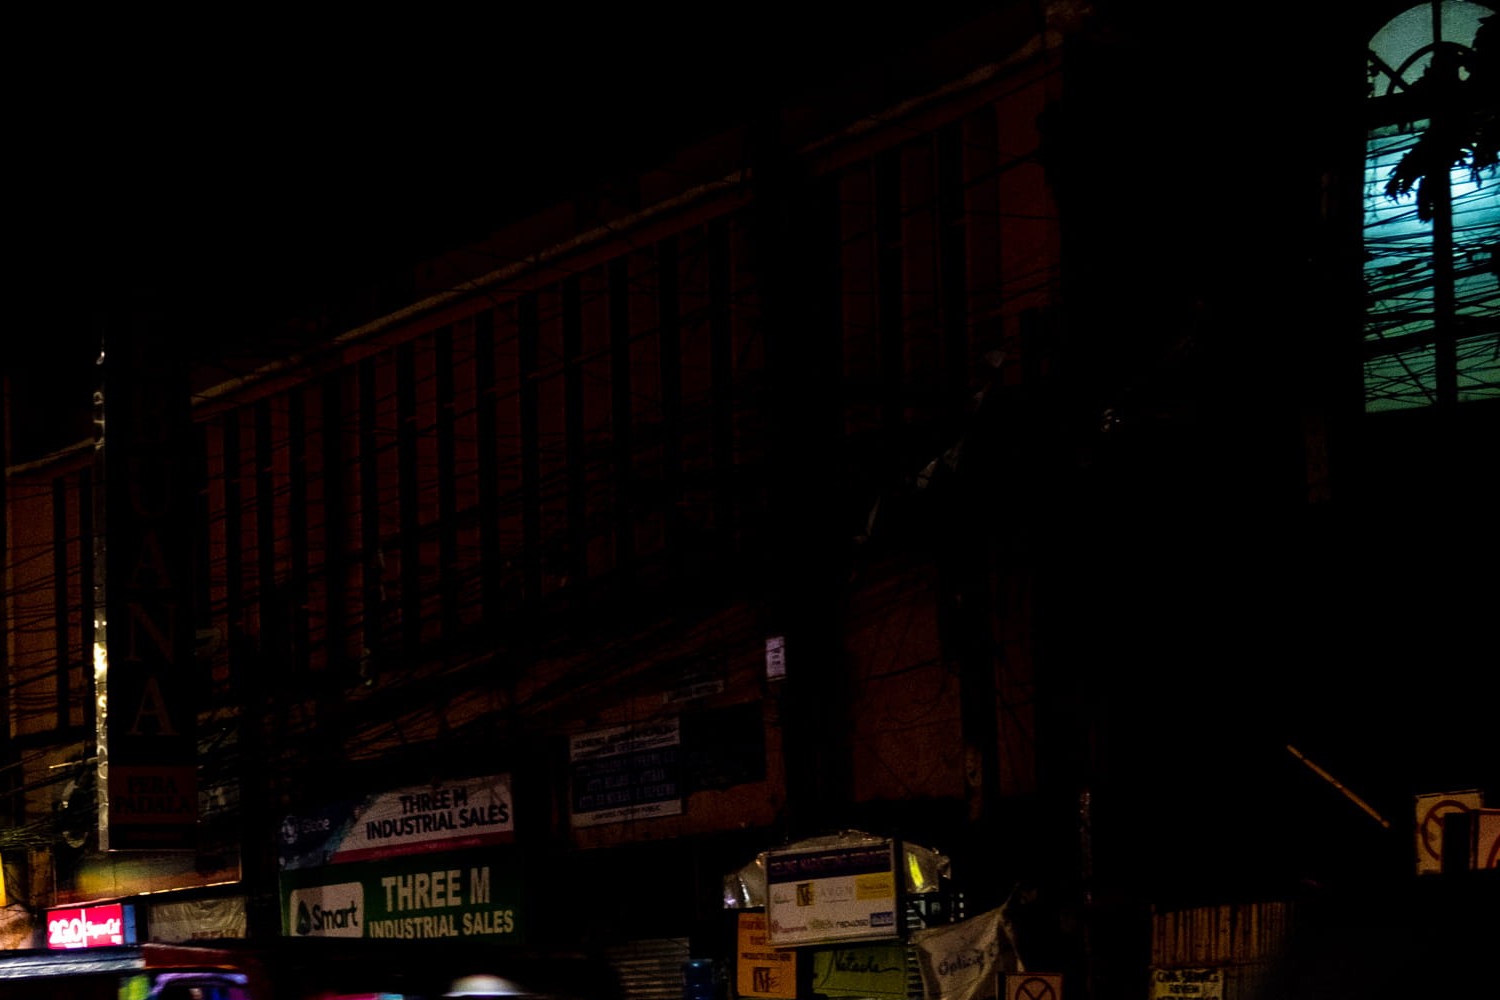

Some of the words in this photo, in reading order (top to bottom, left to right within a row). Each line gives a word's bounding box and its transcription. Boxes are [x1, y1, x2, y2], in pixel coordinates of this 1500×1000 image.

[400, 791, 453, 815] THREE
[454, 787, 468, 807] M
[366, 812, 457, 840] INDUSTRIAL
[459, 803, 509, 829] SALES
[381, 869, 462, 912] THREE
[469, 866, 491, 905] M
[49, 918, 82, 944] 2GO
[312, 900, 358, 931] Smart
[368, 913, 459, 940] INDUSTRIAL
[462, 909, 515, 937] SALES
